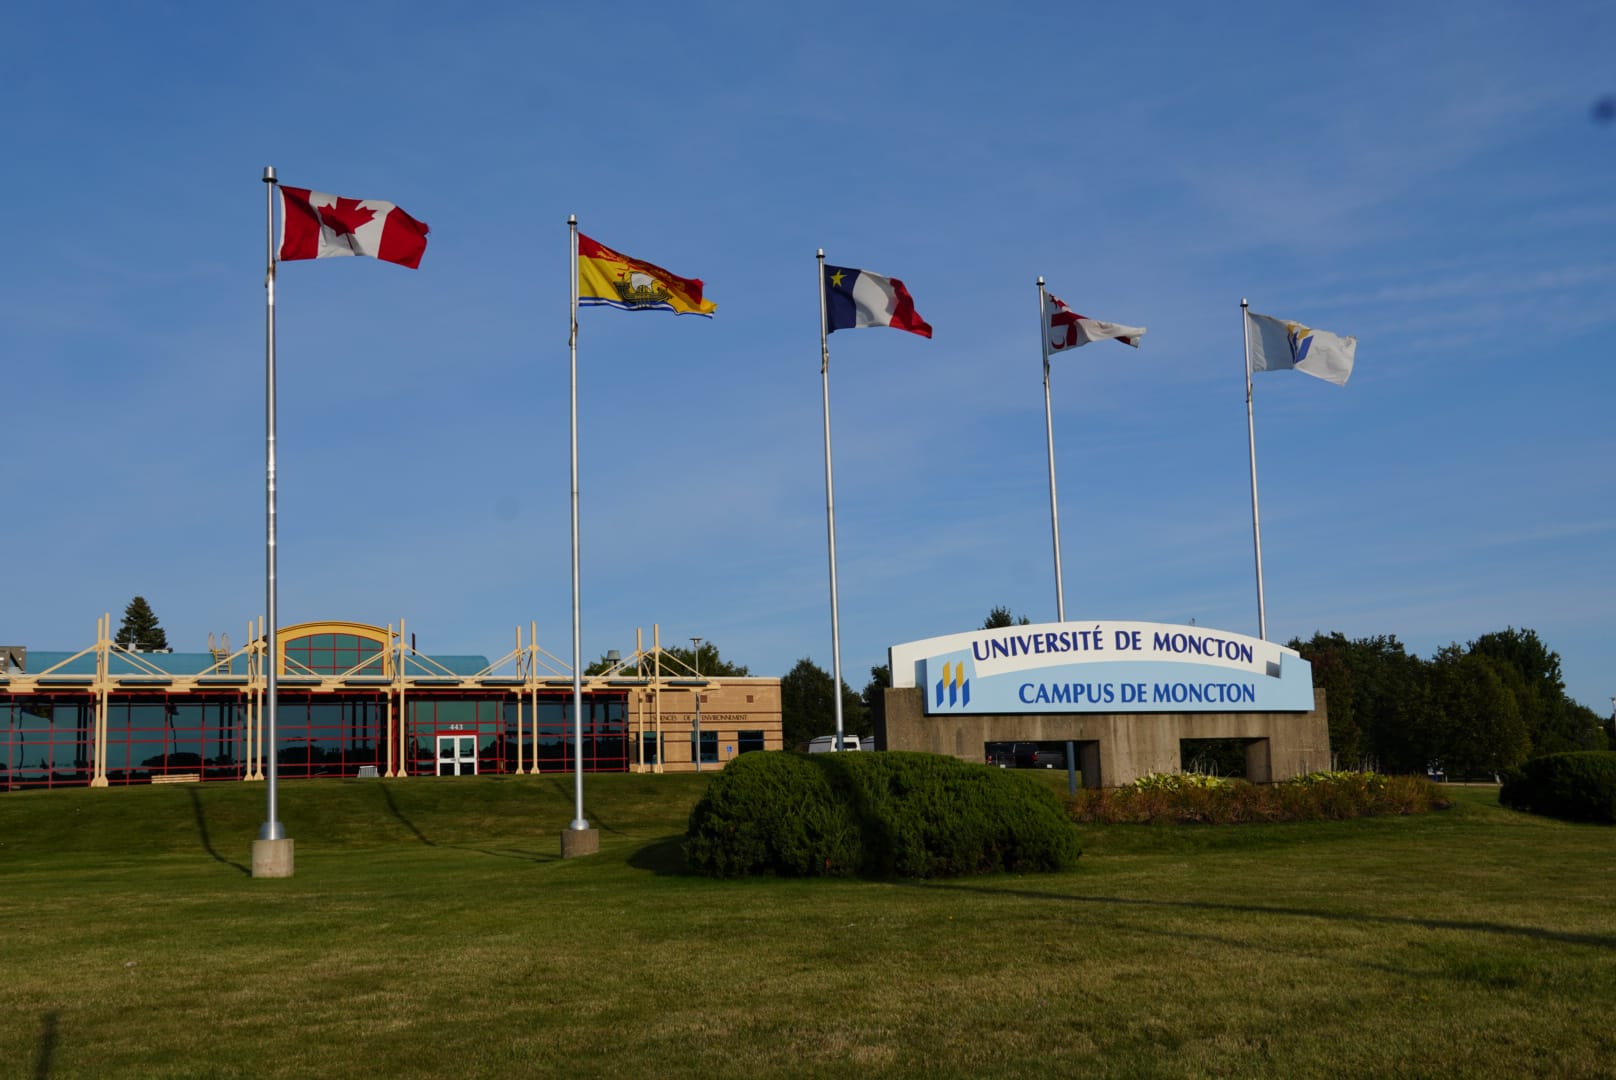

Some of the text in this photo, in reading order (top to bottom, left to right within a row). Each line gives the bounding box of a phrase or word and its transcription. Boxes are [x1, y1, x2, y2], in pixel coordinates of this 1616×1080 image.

[972, 625, 1253, 664] UNIVERSITÉ DE MONCTON
[1018, 683, 1255, 704] CAMPUS DE MONCTON
